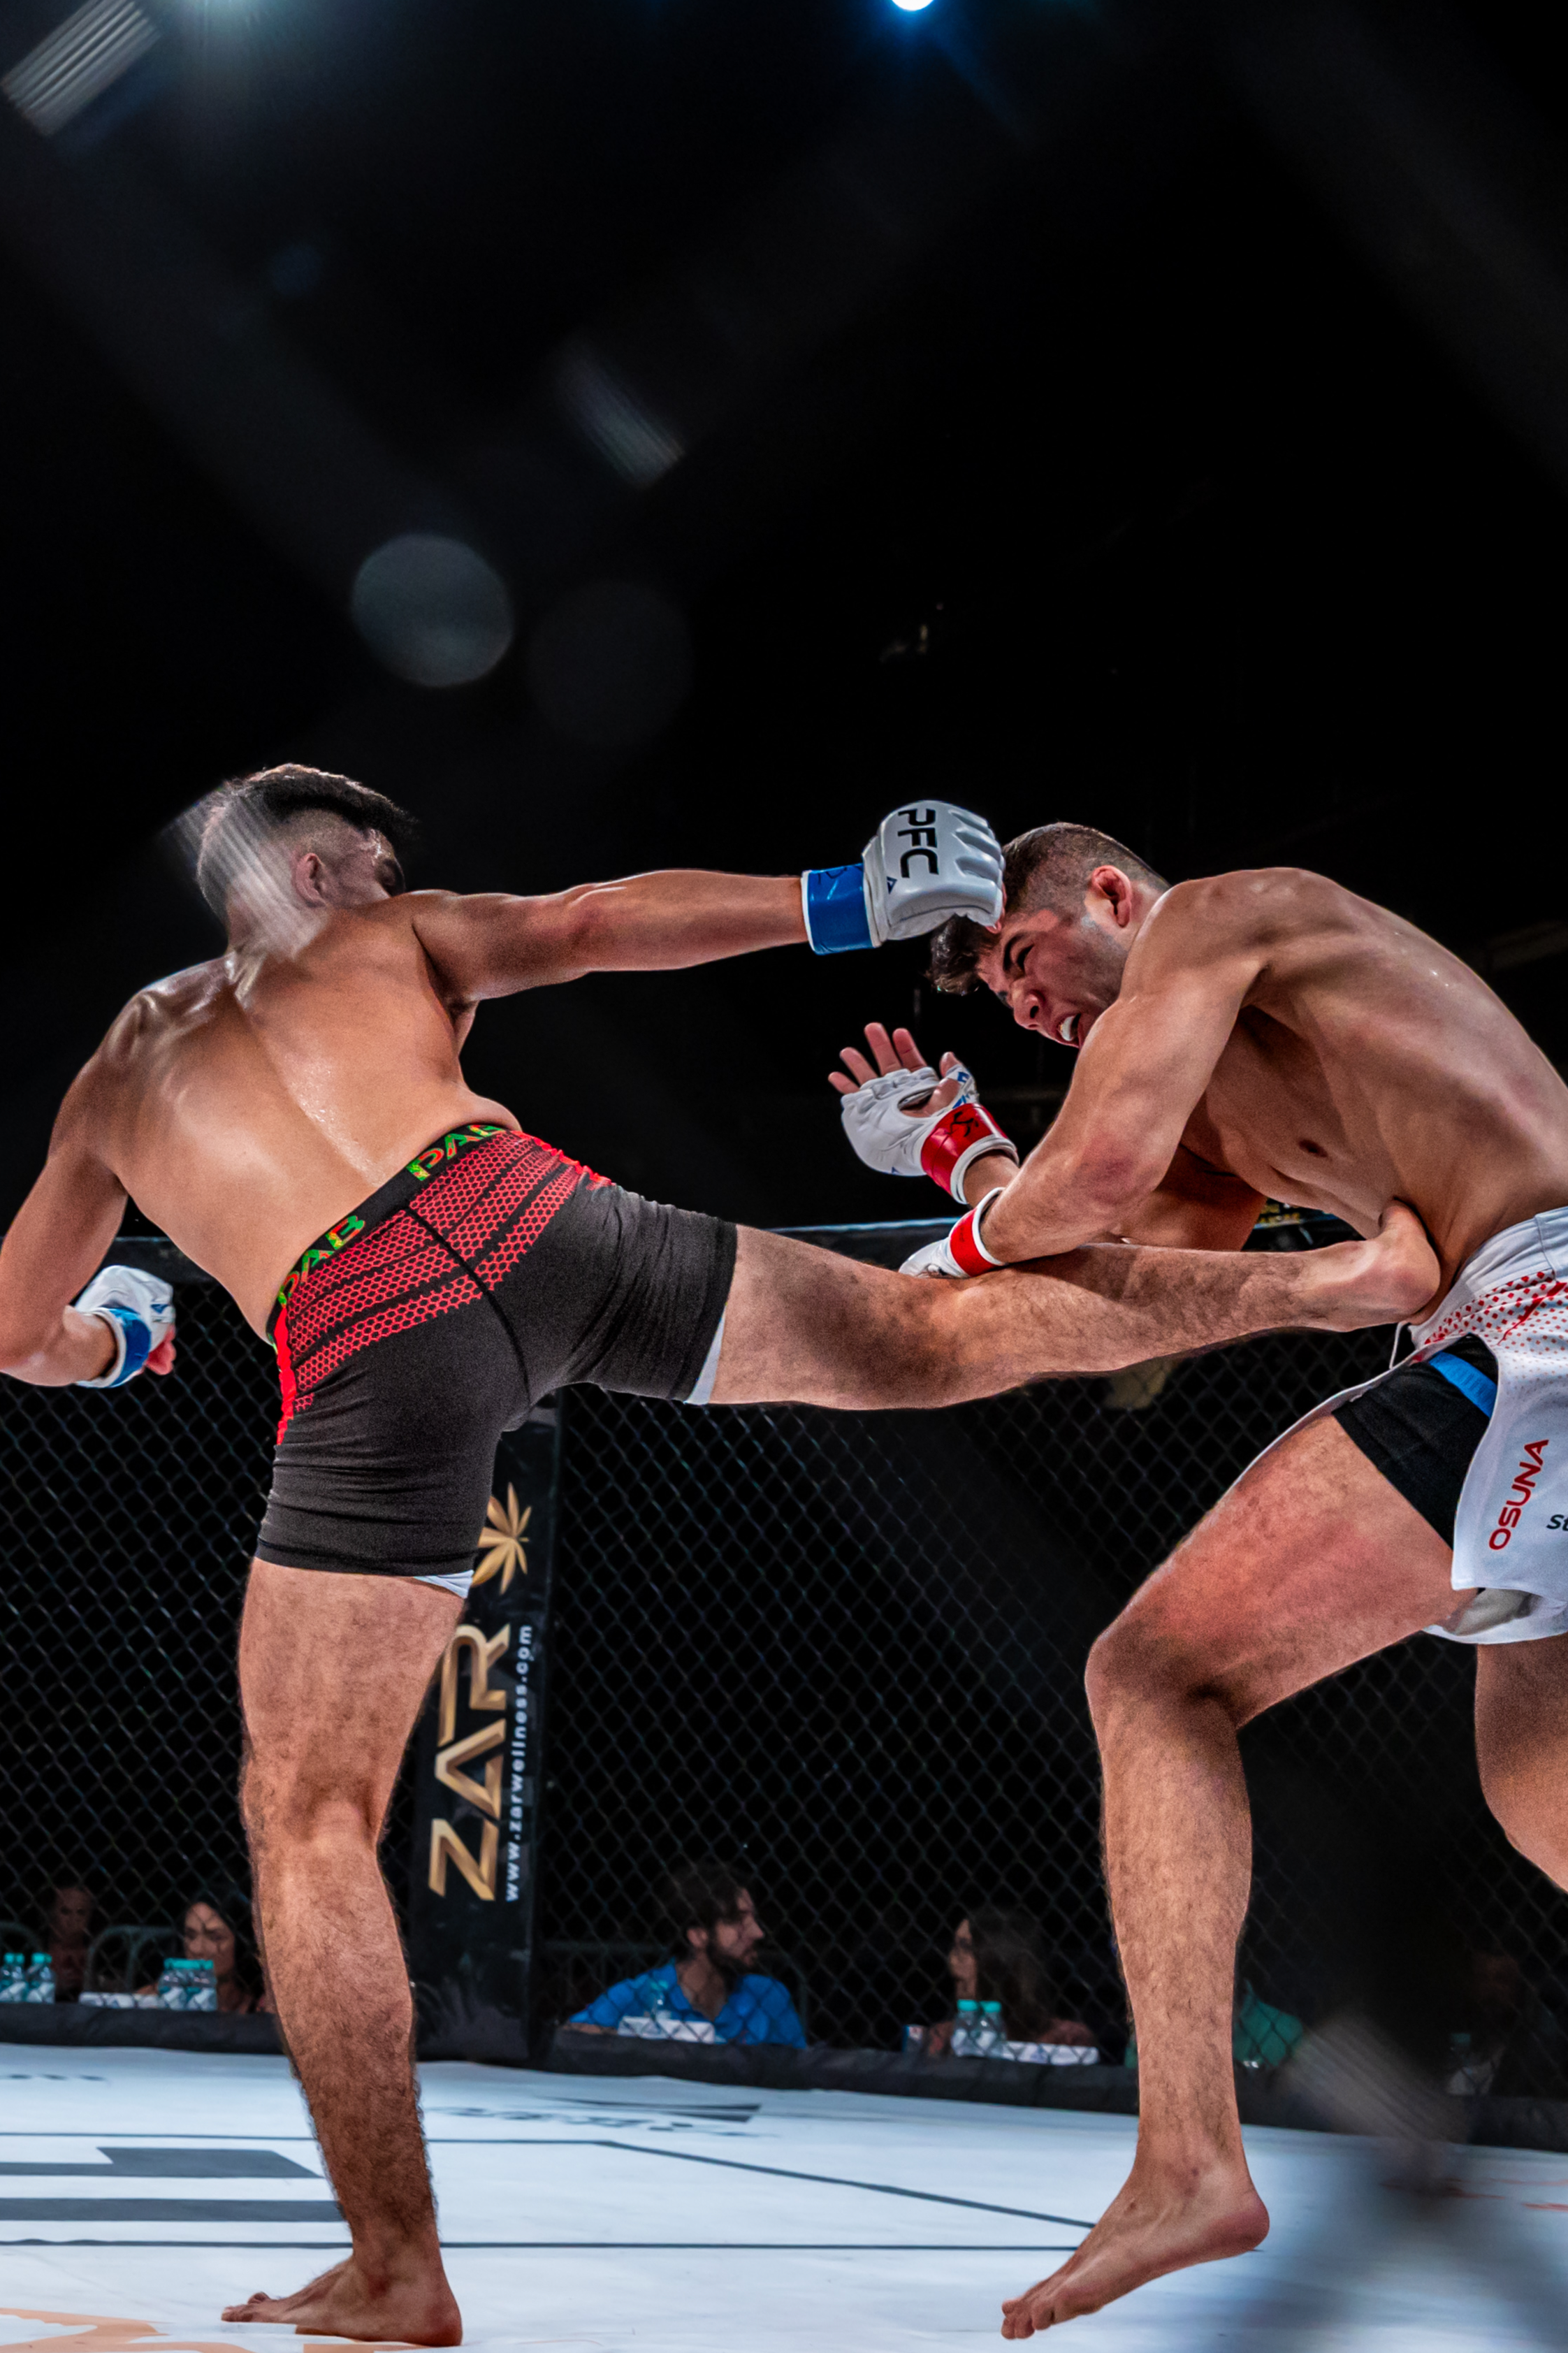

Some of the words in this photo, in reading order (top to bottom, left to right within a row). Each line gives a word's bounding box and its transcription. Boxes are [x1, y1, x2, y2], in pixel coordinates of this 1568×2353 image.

[897, 809, 939, 878] PFC
[1488, 1439, 1550, 1551] OSUNA
[428, 1623, 510, 1902] ZAR
[506, 1625, 532, 1902] www.zarwellness.com
